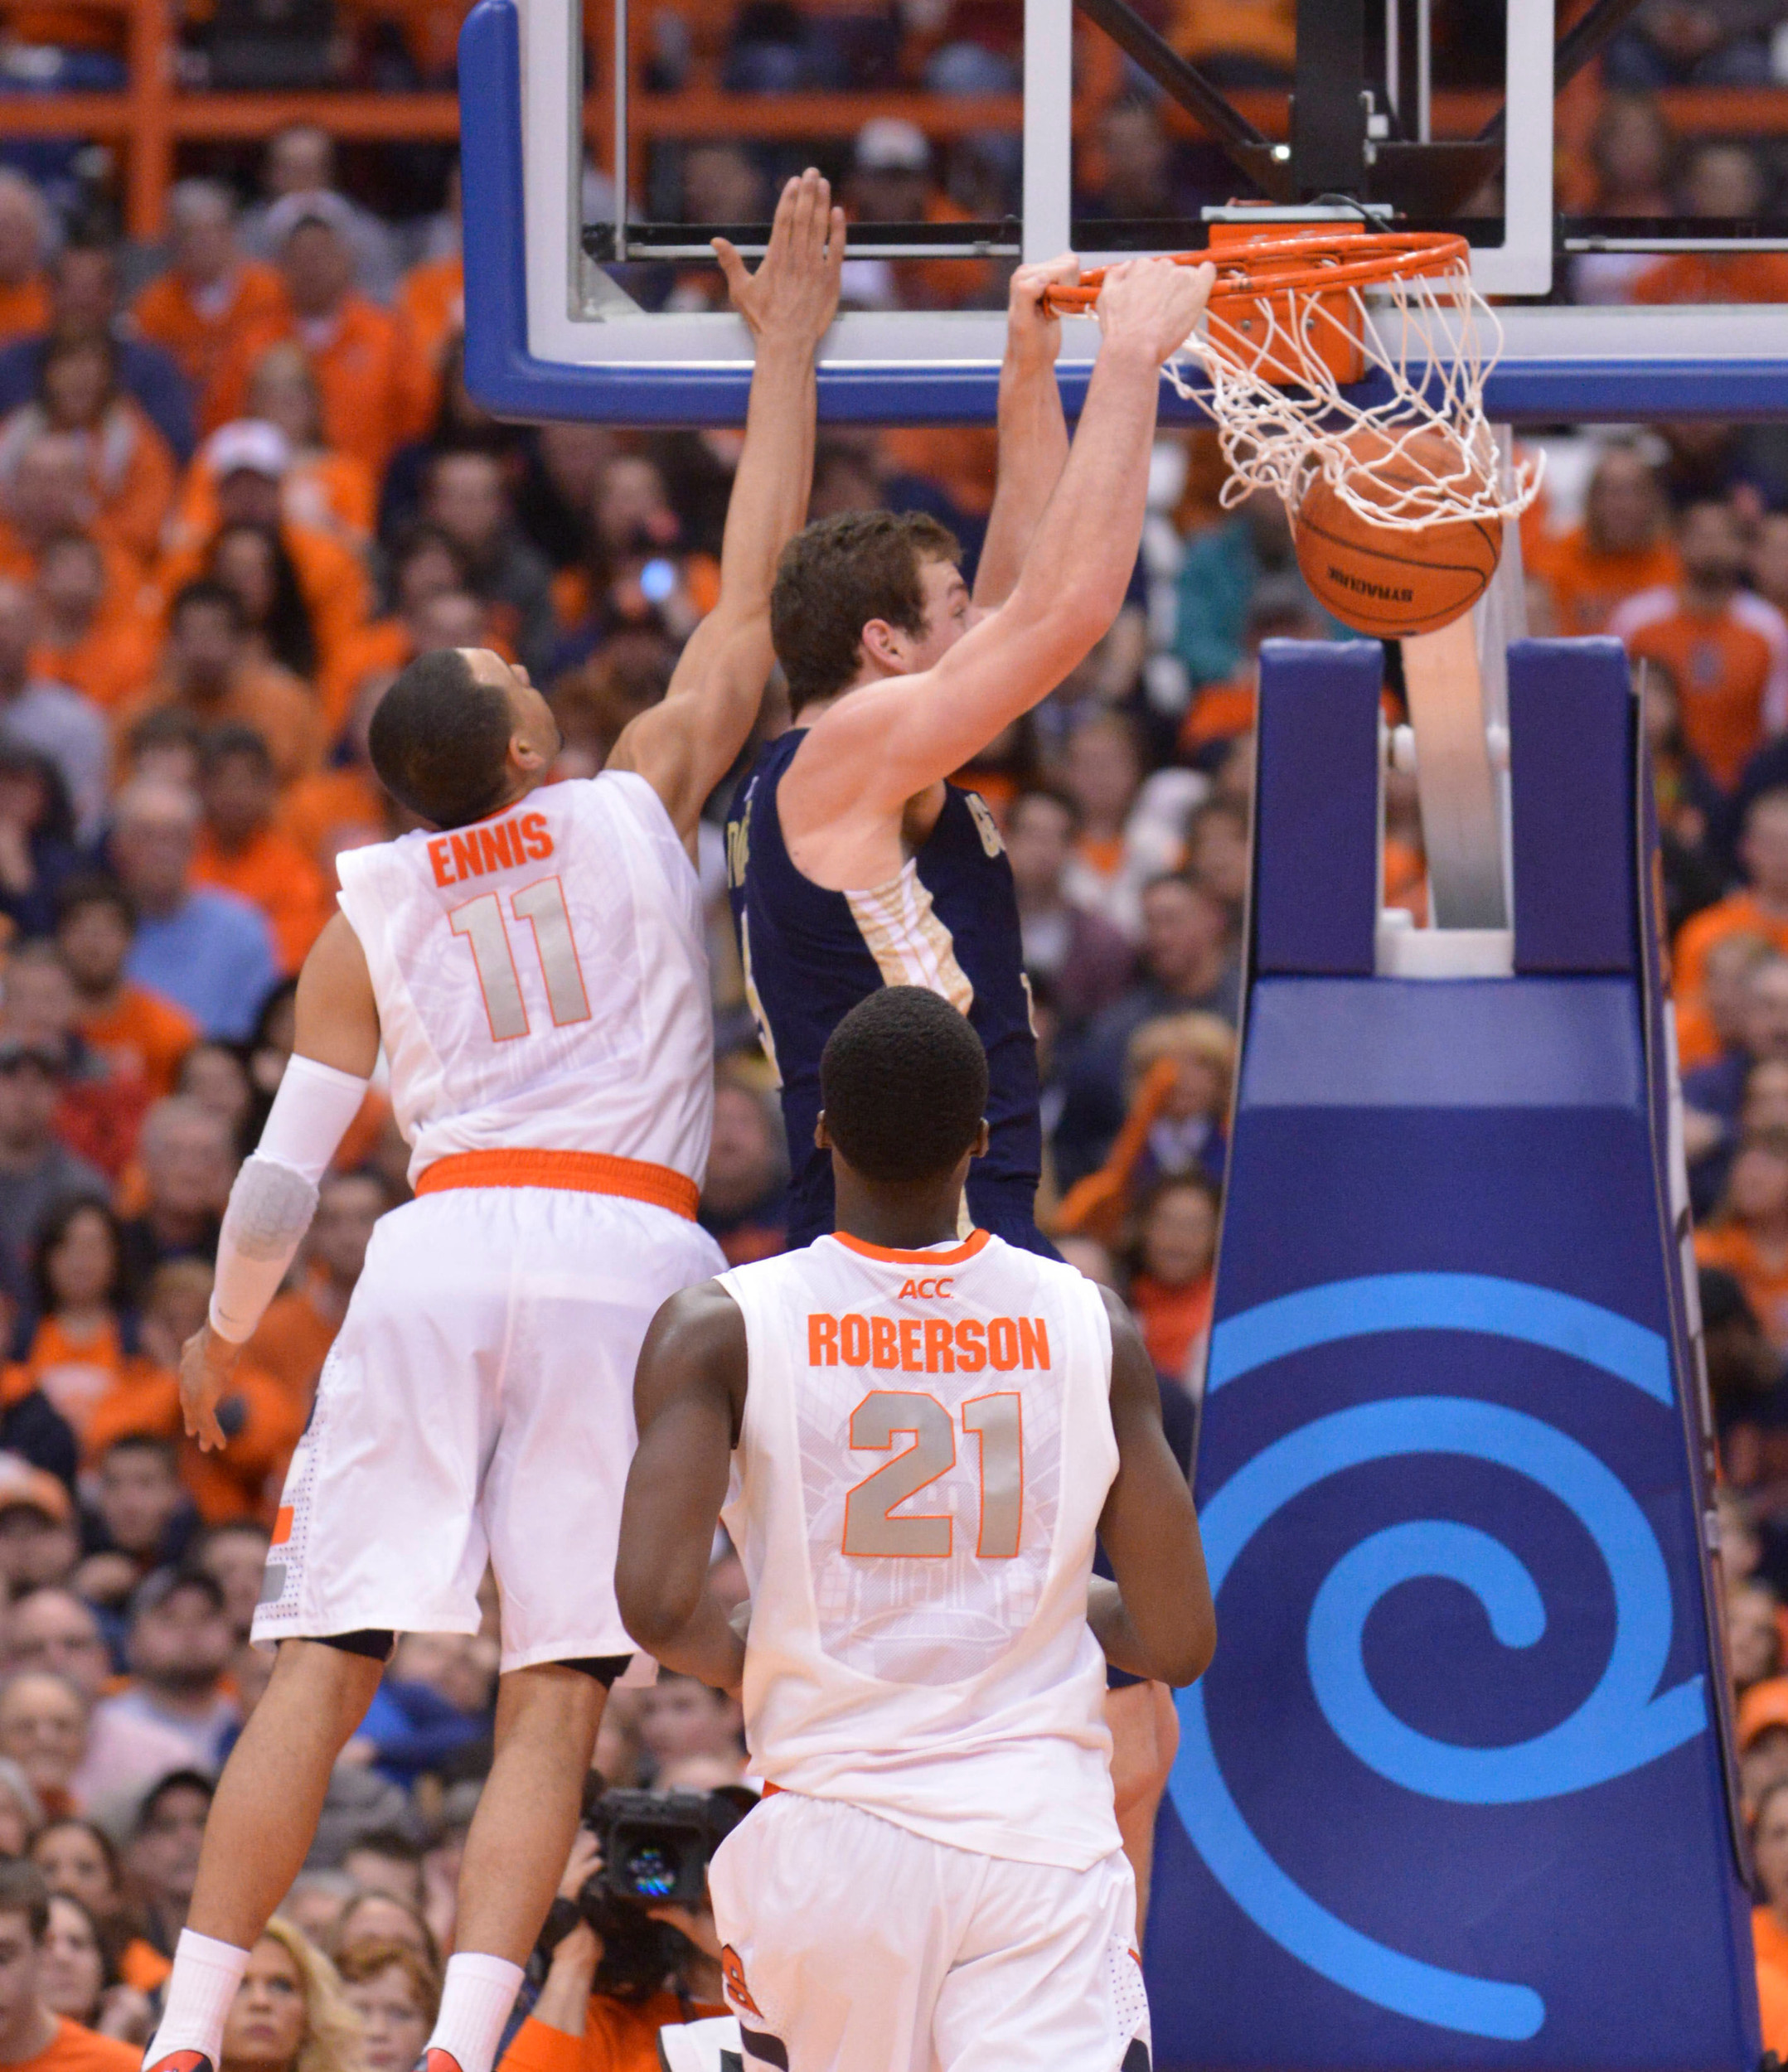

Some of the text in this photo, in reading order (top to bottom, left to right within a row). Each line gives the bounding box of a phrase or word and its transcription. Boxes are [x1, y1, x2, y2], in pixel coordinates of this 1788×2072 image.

[427, 812, 554, 888] ENNIS
[448, 874, 592, 1042] 11
[898, 1278, 955, 1300] ACC
[808, 1314, 1051, 1373] ROBERSON
[841, 1390, 1024, 1558] 21
